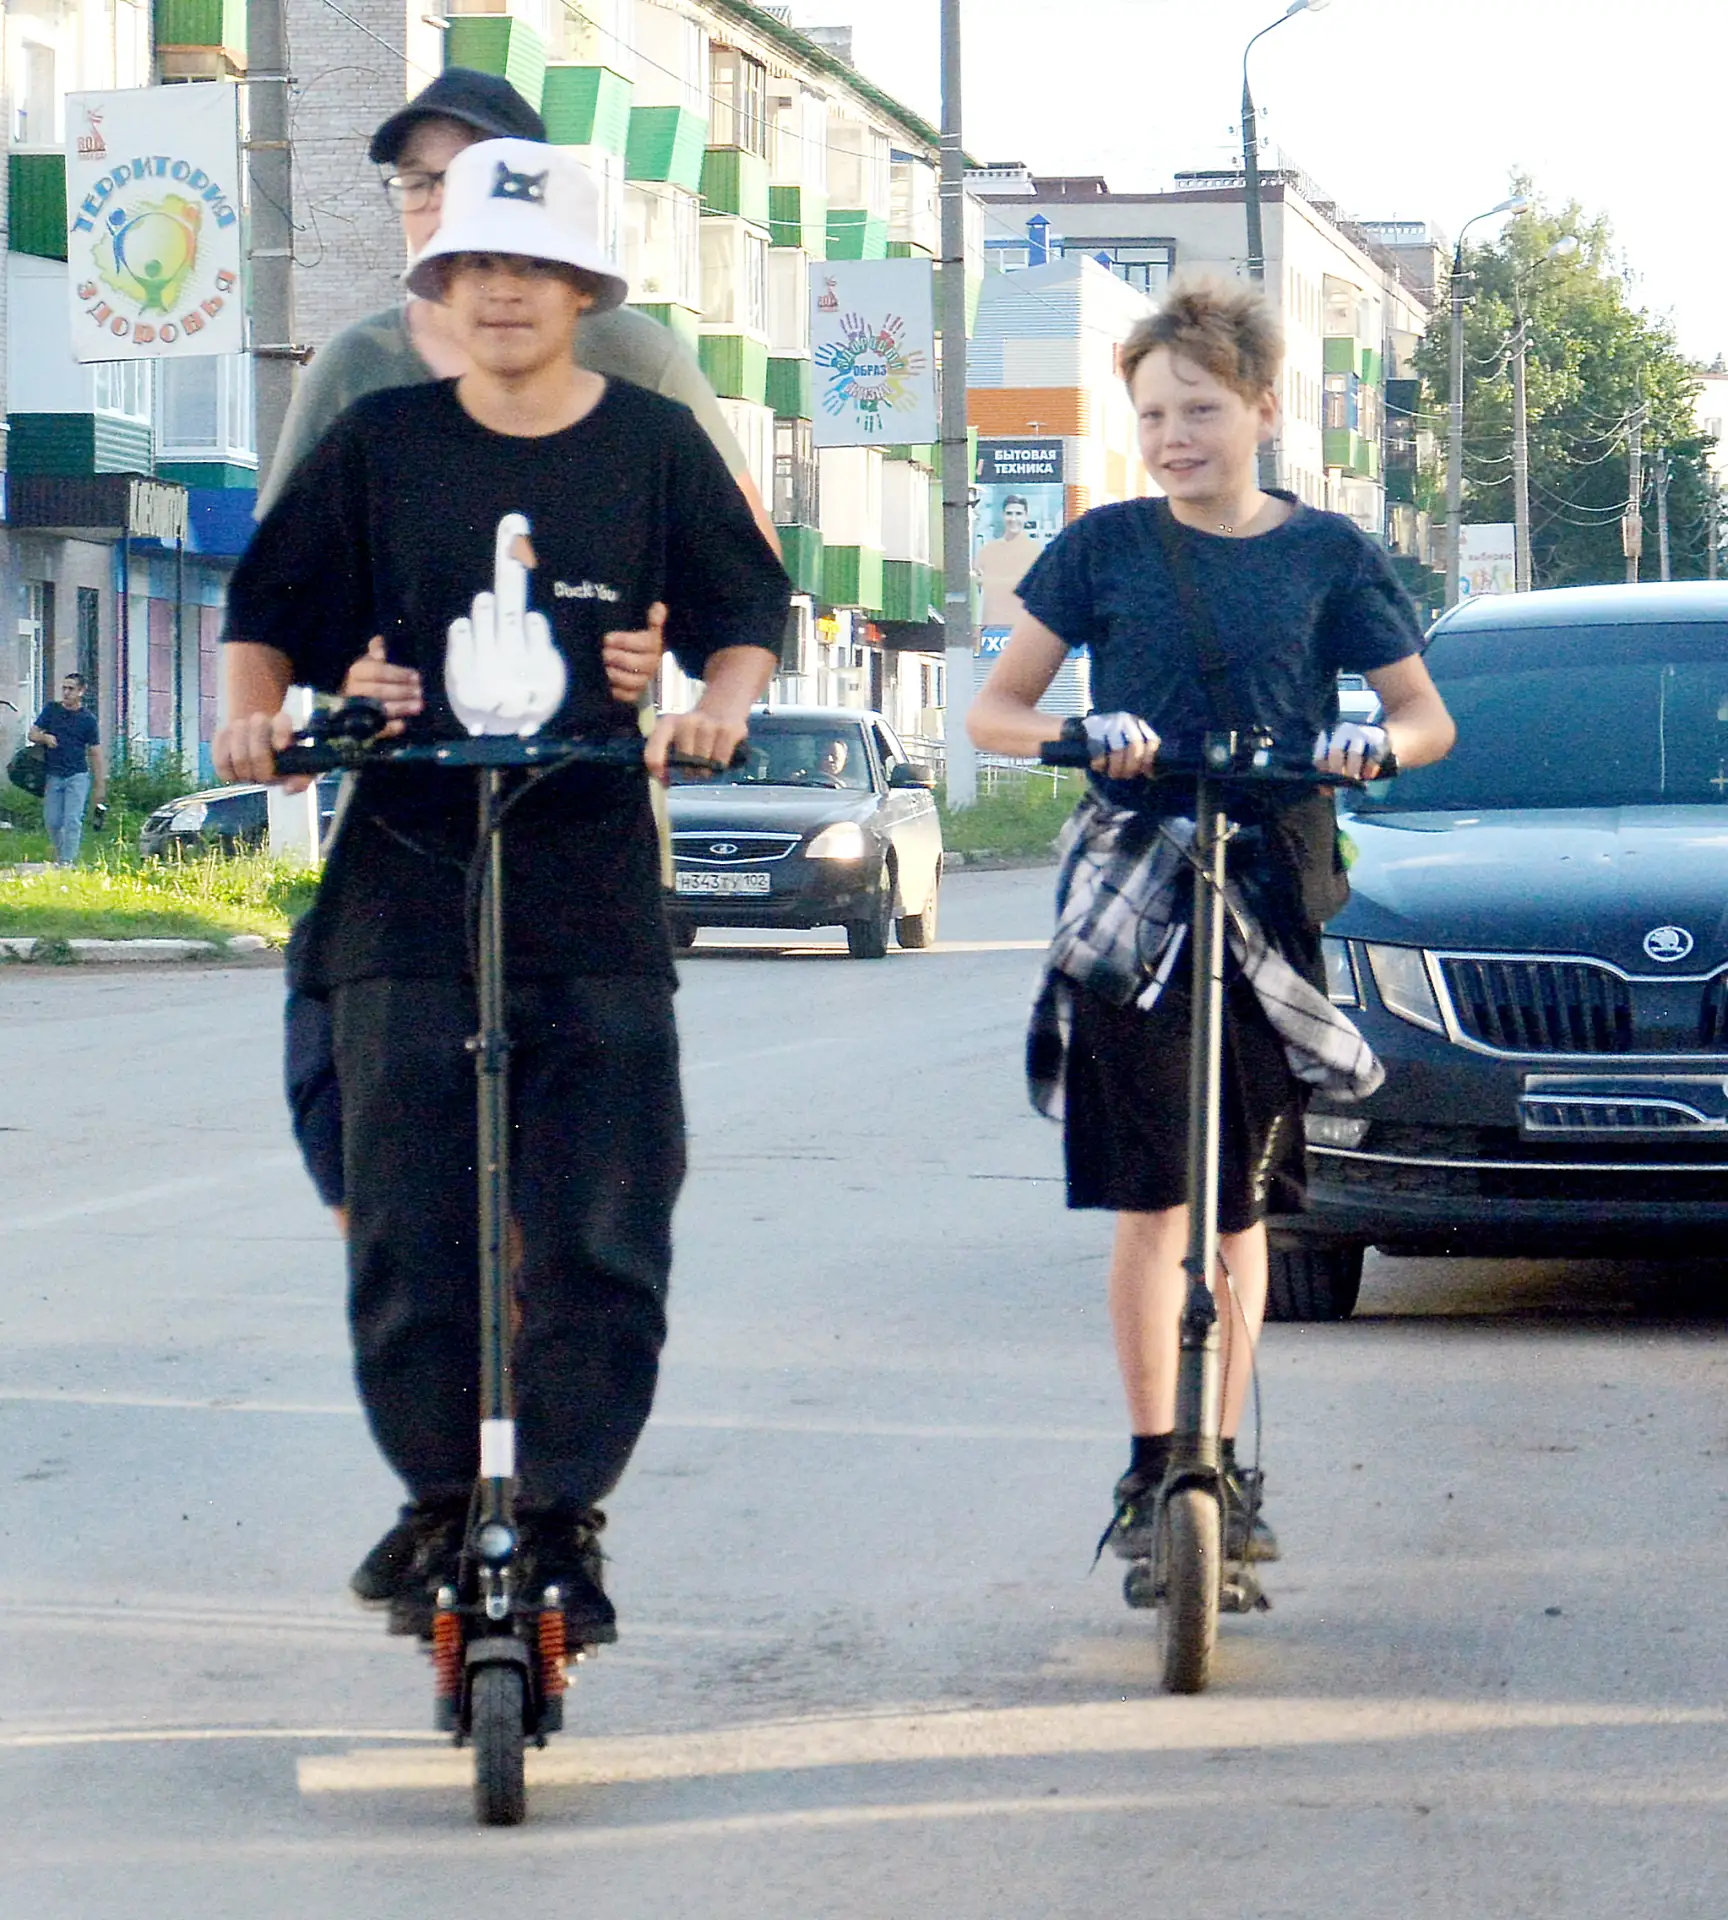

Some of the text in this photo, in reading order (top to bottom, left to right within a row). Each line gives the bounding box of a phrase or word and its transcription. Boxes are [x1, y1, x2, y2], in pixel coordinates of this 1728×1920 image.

[71, 156, 237, 233] ТЕРРИТОРИЯ
[77, 268, 237, 345] ЗДОРОВЬЯ
[853, 364, 887, 377] ОБРАЗ
[994, 449, 1057, 461] БЫТОВАЯ
[994, 463, 1054, 474] ТЕХНИКА
[594, 583, 619, 602] You
[744, 874, 768, 887] 102
